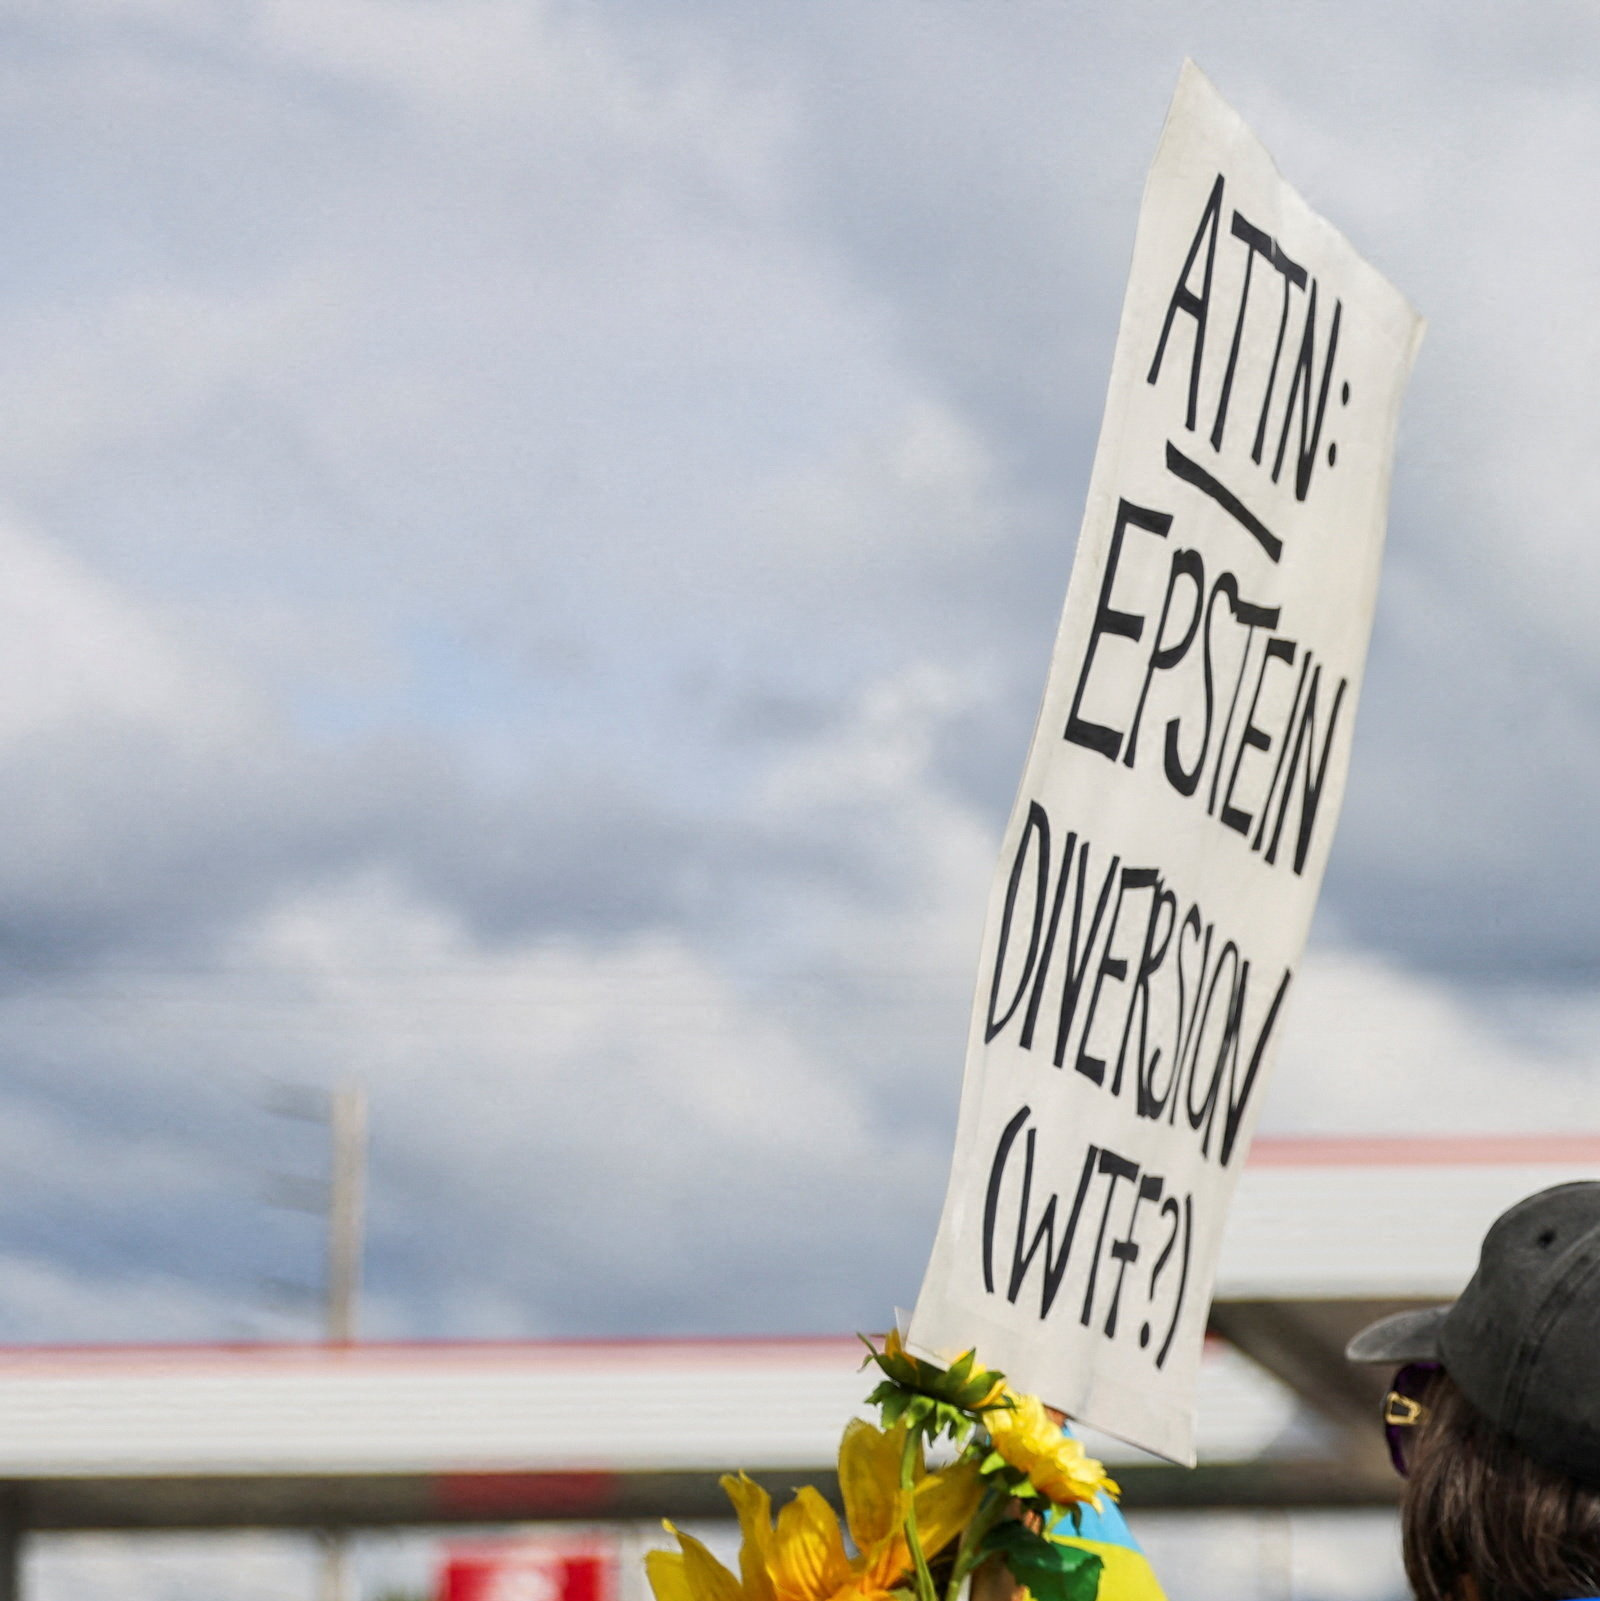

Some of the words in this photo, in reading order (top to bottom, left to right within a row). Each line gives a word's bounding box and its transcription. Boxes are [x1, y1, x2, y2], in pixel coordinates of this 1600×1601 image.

[1147, 173, 1351, 501] ATTN:
[1064, 497, 1348, 876] EPSTEIN
[984, 799, 1291, 1167] DIVERSION
[983, 1104, 1193, 1369] (WTF?)
